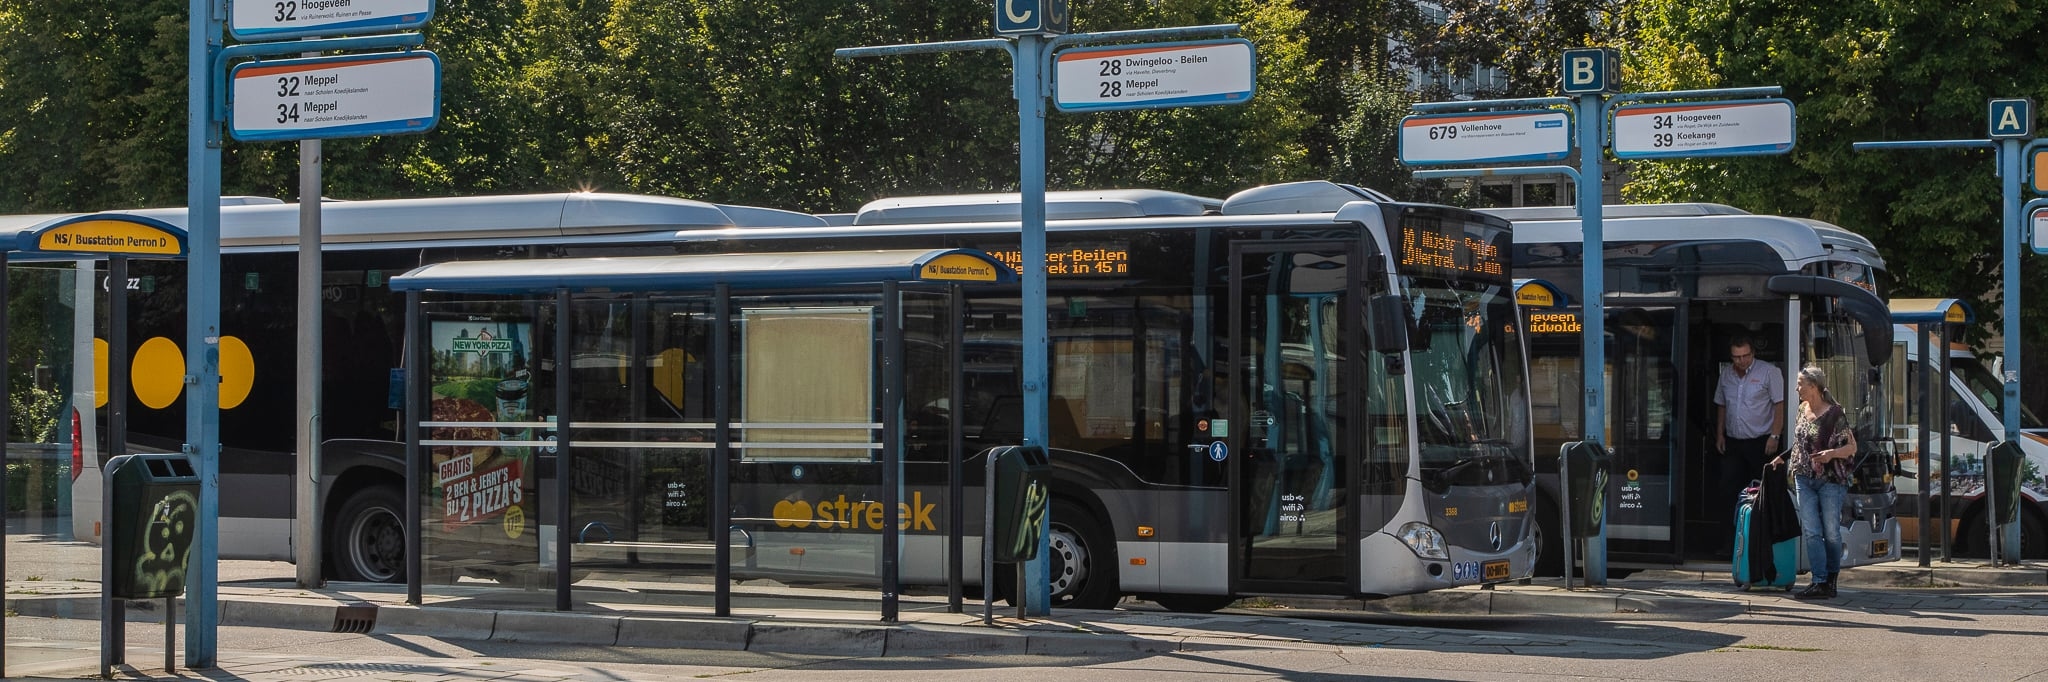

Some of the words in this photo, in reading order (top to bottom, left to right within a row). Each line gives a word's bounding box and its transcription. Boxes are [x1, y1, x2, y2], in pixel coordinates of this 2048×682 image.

[275, 1, 296, 22] 32
[302, 0, 350, 10] Hoogeveen
[1005, 0, 1032, 23] C
[1049, 0, 1063, 24] C
[1100, 60, 1122, 76] 28
[1126, 57, 1172, 67] Dwingeloo
[1181, 55, 1208, 64] Beilen
[1573, 57, 1594, 84] B
[1610, 57, 1617, 84] B
[278, 76, 299, 97] 32
[305, 74, 338, 87] Meppel
[1100, 81, 1122, 97] 28
[1126, 79, 1158, 89] Meppel
[277, 103, 299, 123] 34
[304, 101, 337, 113] Meppel
[1653, 115, 1673, 130] 34
[1677, 114, 1721, 122] Hoogeveen
[1998, 106, 2020, 130] A
[1429, 126, 1457, 140] 679
[1461, 124, 1502, 132] Vollenhove
[1653, 133, 1673, 147] 39
[1677, 132, 1716, 140] Koekange
[54, 233, 72, 246] NS/
[76, 234, 124, 246] Busstation
[128, 236, 157, 247] Perron
[160, 238, 166, 247] D
[929, 265, 939, 275] NS/
[940, 266, 967, 274] Busstation
[985, 267, 989, 276] C
[1072, 262, 1089, 273] in
[1095, 262, 1113, 273] 15
[1117, 263, 1127, 273] m
[454, 341, 472, 349] NEW
[472, 341, 492, 349] YORK
[441, 457, 471, 480] GRATIS
[446, 486, 452, 500] 2
[454, 480, 468, 498] BEN
[471, 478, 476, 493] &
[479, 467, 508, 490] JERRY'S
[446, 499, 458, 516] BIJ
[461, 496, 469, 522] 2
[473, 478, 522, 518] PIZZA'S
[1282, 493, 1295, 501] usb
[817, 491, 936, 530] streek
